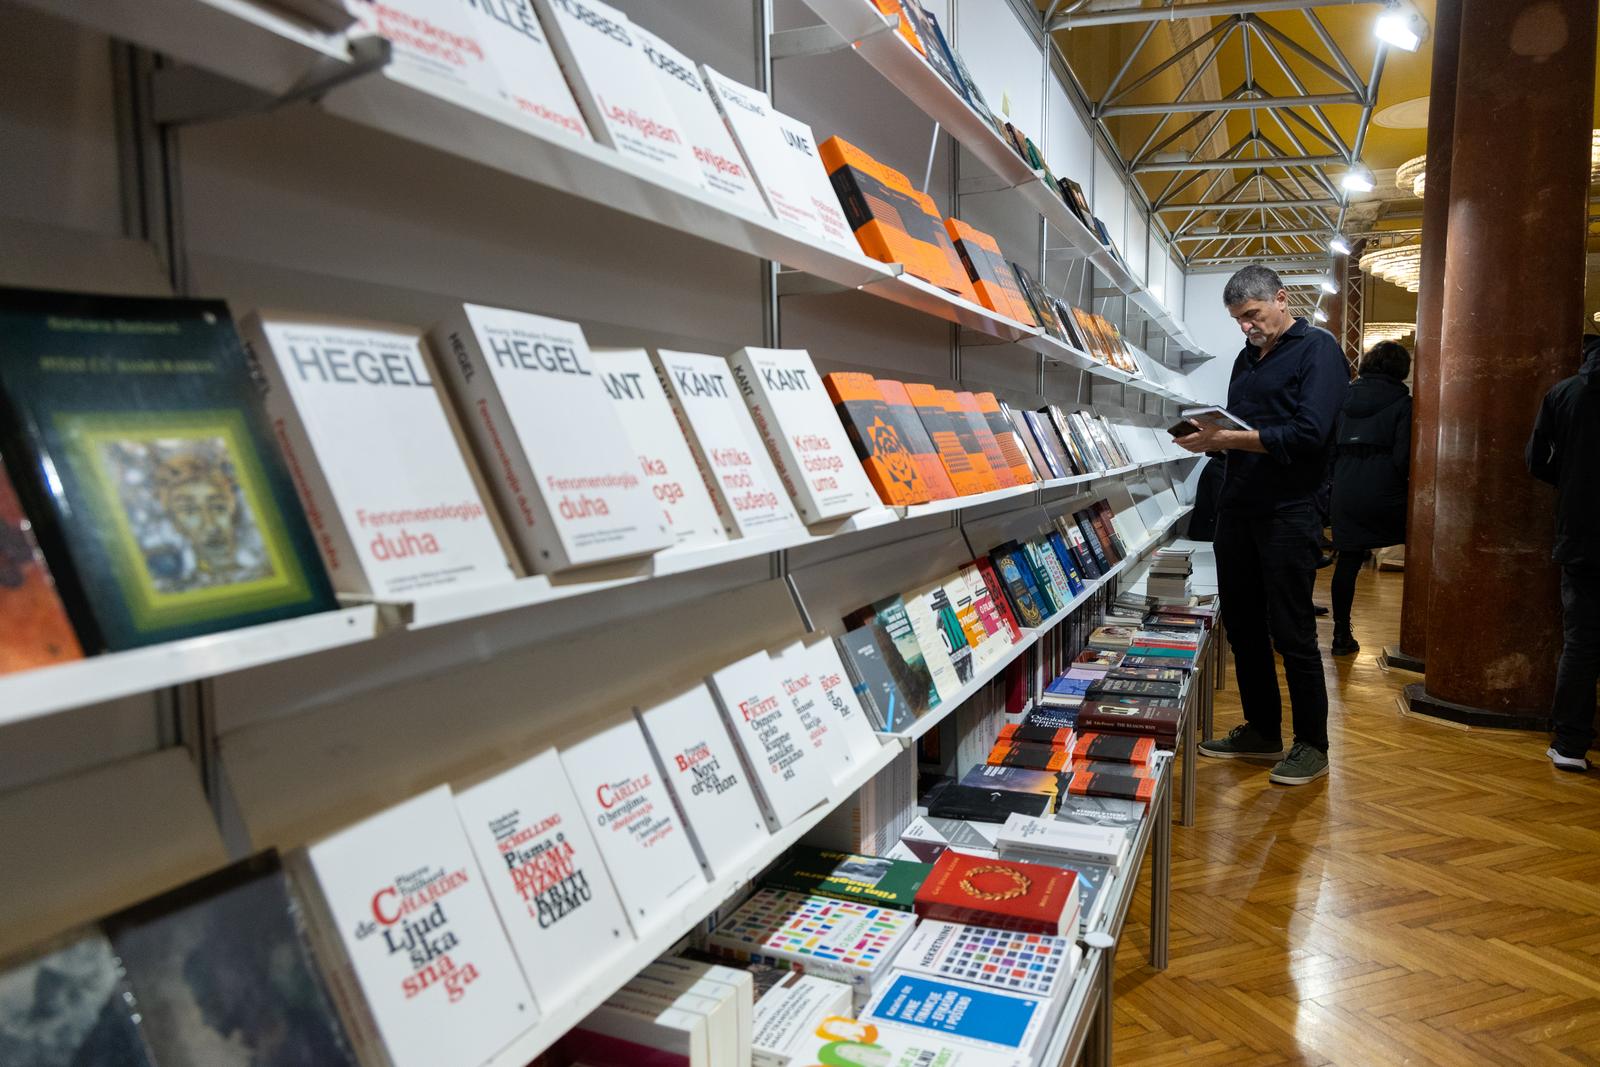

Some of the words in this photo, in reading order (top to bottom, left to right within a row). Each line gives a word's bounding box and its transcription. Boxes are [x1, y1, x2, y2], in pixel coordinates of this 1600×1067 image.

[290, 346, 434, 387] HEGEL
[449, 332, 475, 383] HEGEL
[488, 337, 592, 376] HEGEL
[674, 371, 728, 398] KANT
[734, 365, 753, 397] KANT
[761, 368, 811, 391] KANT
[710, 447, 751, 468] Kritika
[793, 435, 831, 451] Kritika
[803, 455, 844, 473] čistoga
[547, 474, 639, 492] Fenomenologija
[812, 475, 838, 493] uma
[356, 503, 484, 528] Fenomenologija
[559, 495, 609, 521] duha
[371, 530, 440, 561] duha
[738, 696, 778, 722] FICHTE
[751, 709, 783, 731] Osnova
[675, 746, 711, 773] BACON
[691, 755, 720, 782] Novi
[596, 774, 651, 809] CARLYLE
[691, 772, 720, 796] orga
[714, 773, 738, 795] non
[497, 813, 562, 853] SCHELLING
[504, 839, 554, 870] Pisma
[556, 832, 565, 842] o
[510, 840, 576, 886] DOGMA
[516, 856, 575, 902] TIZMU
[534, 869, 589, 915] KRITI
[868, 888, 897, 900] Film
[371, 867, 469, 926] CHARDIN
[537, 886, 592, 929] CIZMU
[354, 918, 378, 941] de
[382, 901, 447, 955] Ljud
[410, 930, 459, 971] ska
[920, 925, 953, 967] NEKRETNINE
[401, 955, 457, 999] sna
[444, 961, 480, 1003] ga
